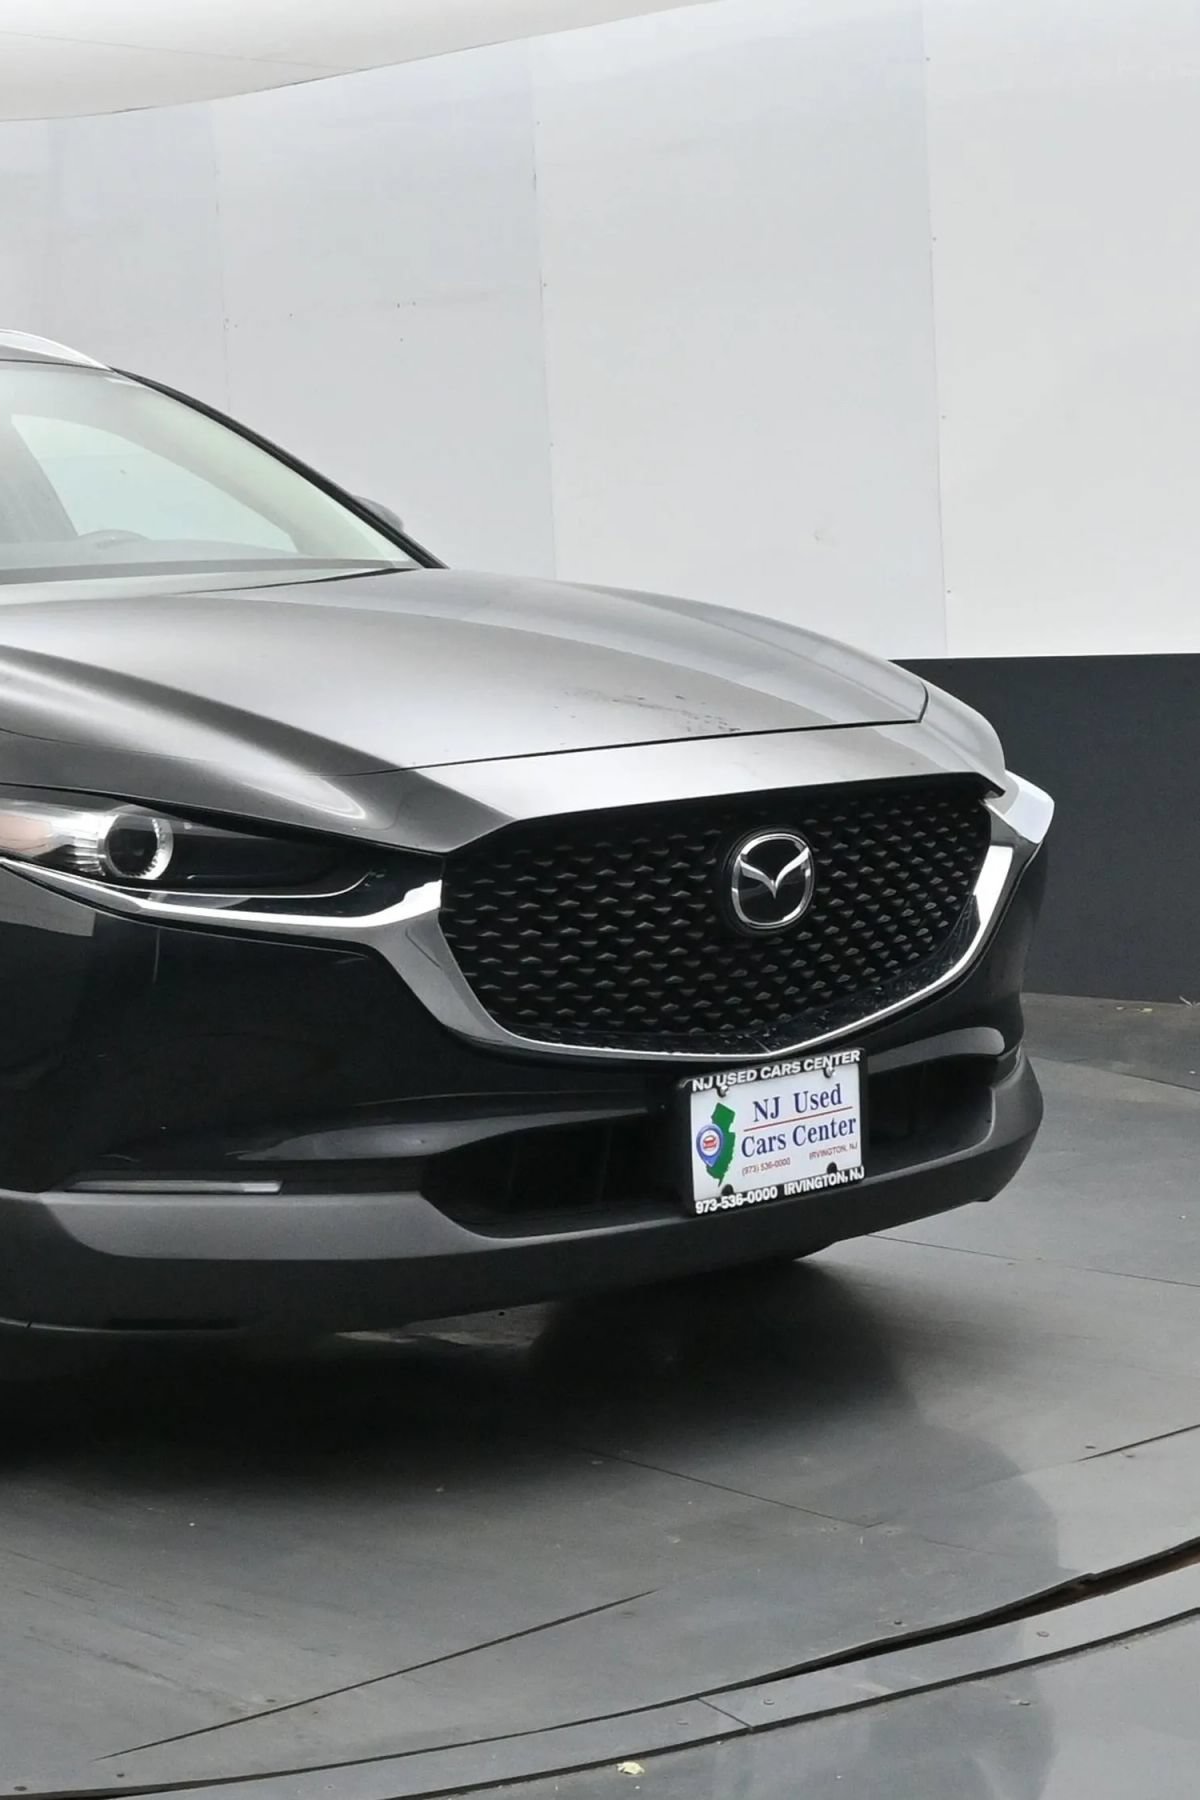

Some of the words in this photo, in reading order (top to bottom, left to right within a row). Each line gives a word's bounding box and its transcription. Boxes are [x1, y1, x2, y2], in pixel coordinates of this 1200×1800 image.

[692, 1076, 713, 1092] NJ
[715, 1069, 757, 1087] USED
[760, 1062, 801, 1079] CARS
[803, 1050, 861, 1069] CENTER
[752, 1096, 780, 1123] NJ
[794, 1083, 842, 1113] Used
[741, 1133, 787, 1158] Cars
[792, 1117, 857, 1147] Center
[849, 1142, 858, 1150] NJ
[783, 1172, 849, 1196] IRVINGTON,
[849, 1166, 865, 1180] NJ
[695, 1186, 778, 1214] 973-536-0000
